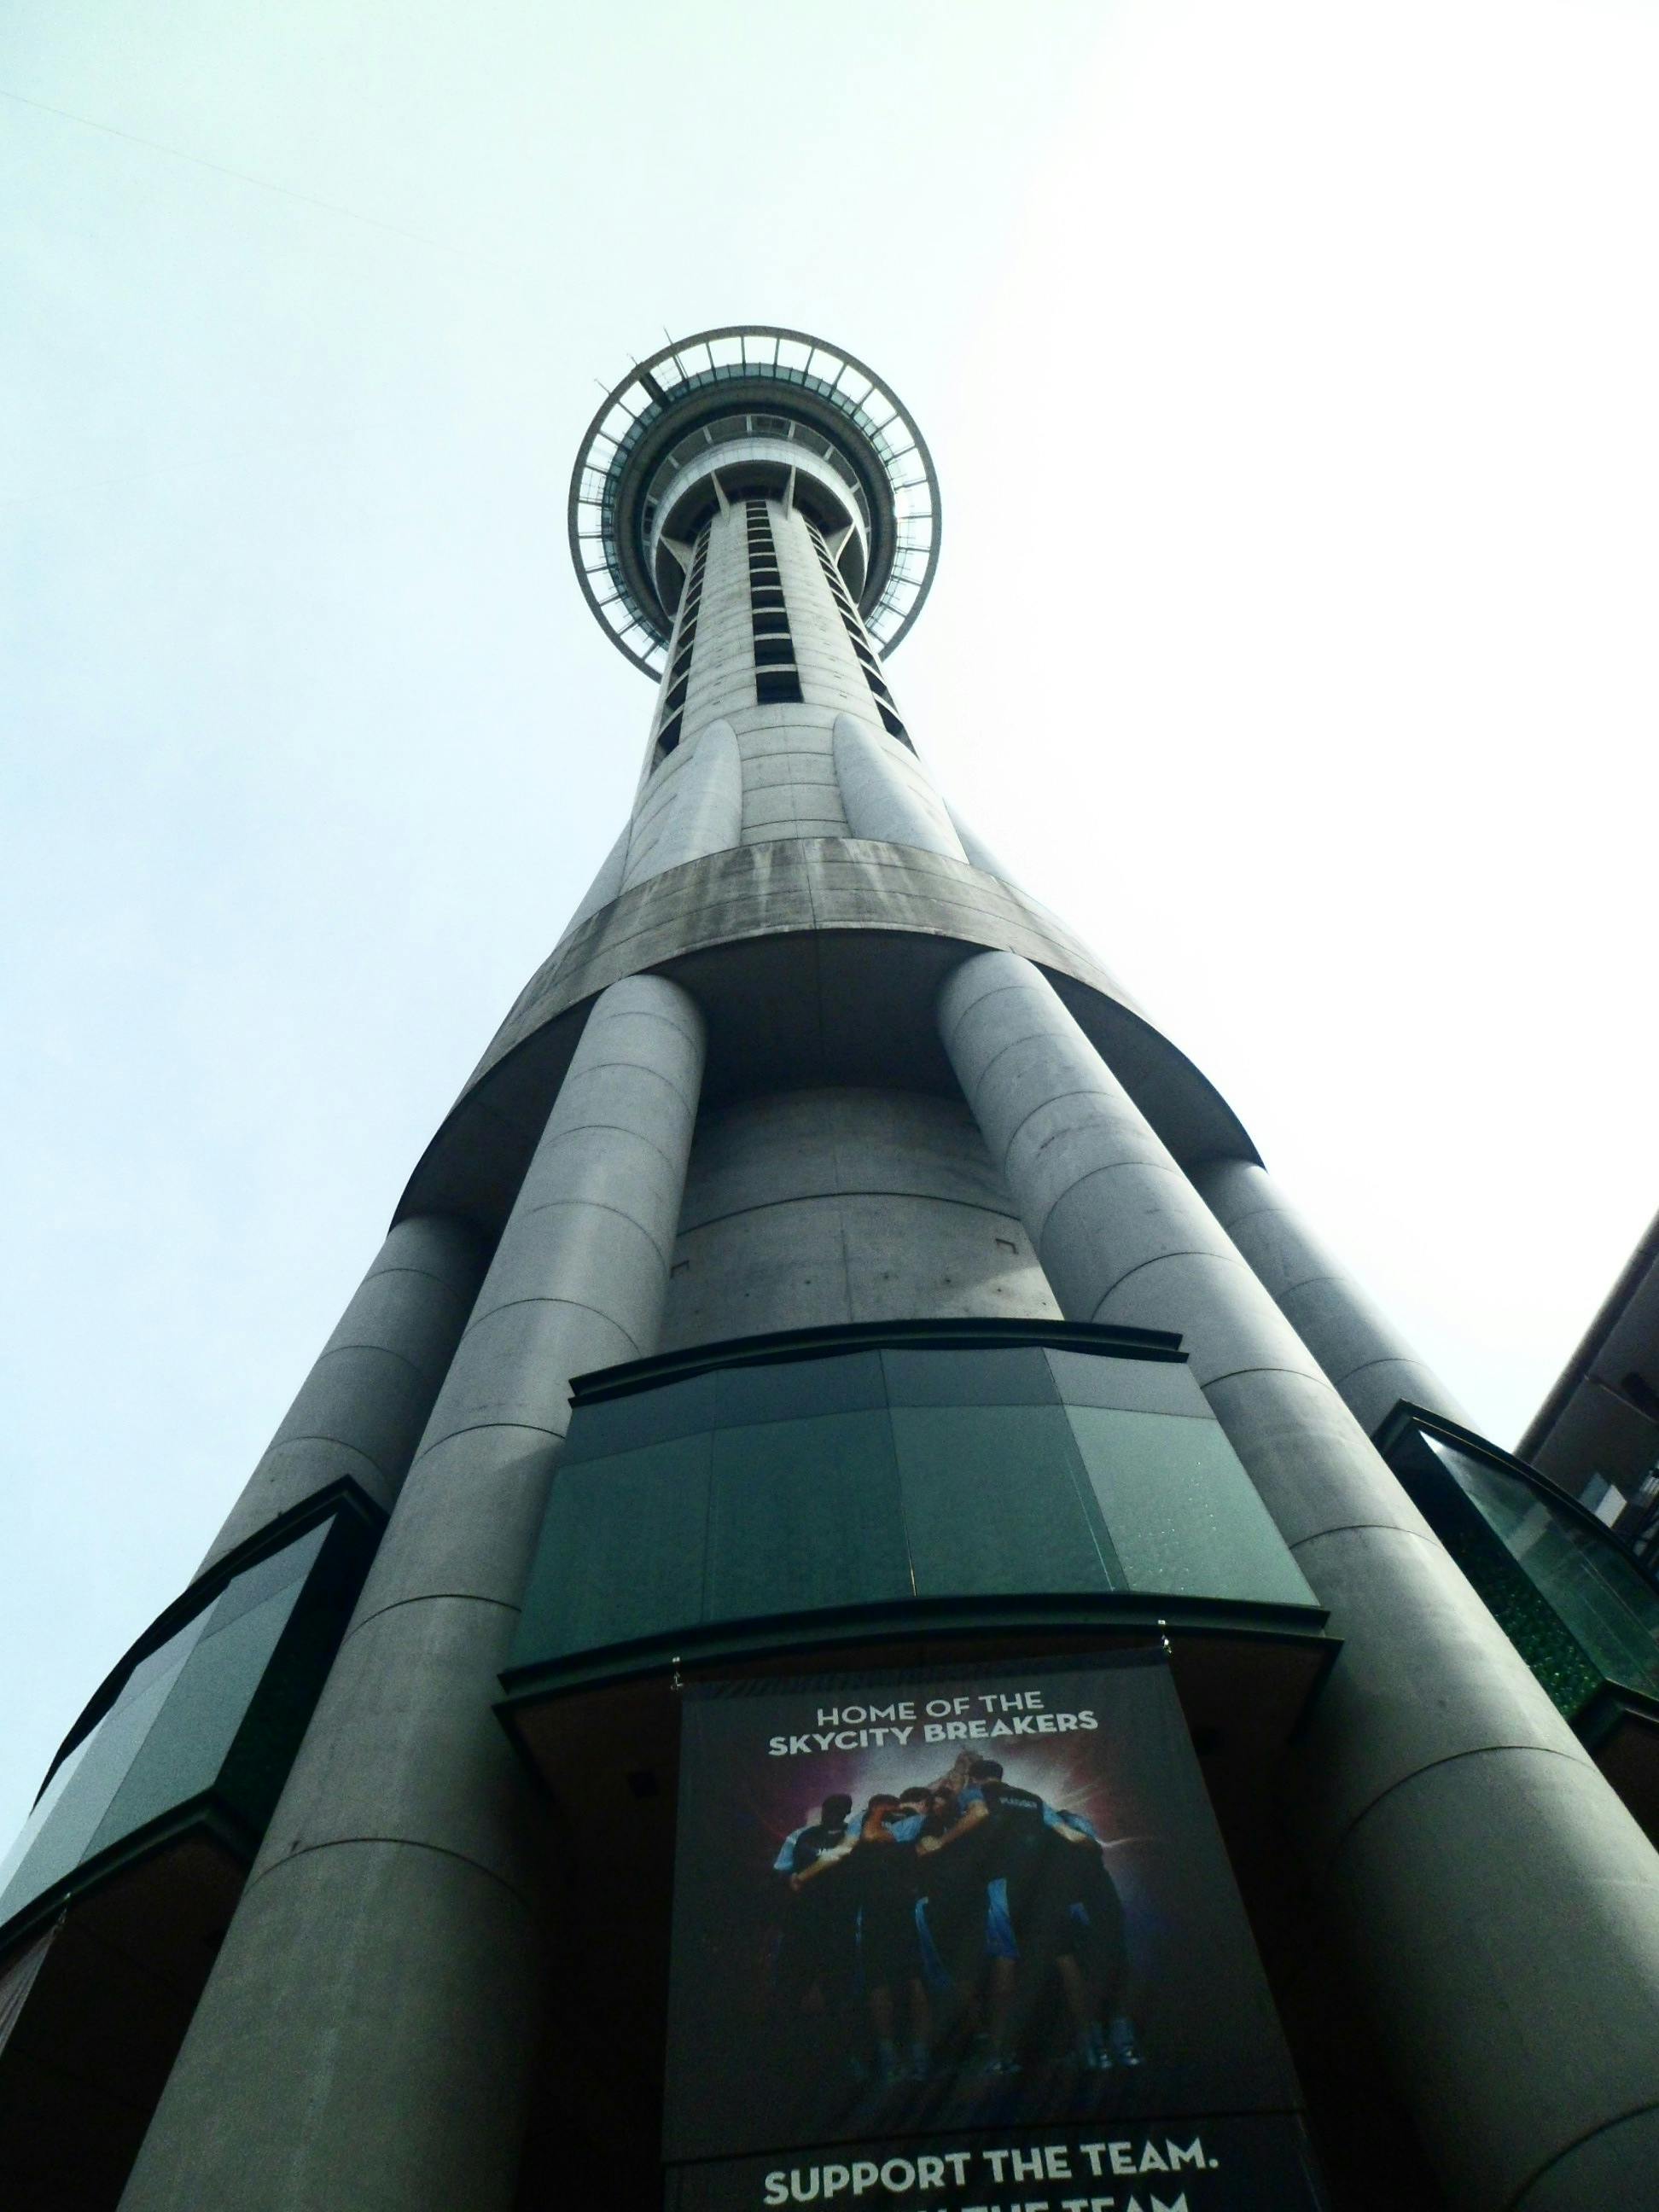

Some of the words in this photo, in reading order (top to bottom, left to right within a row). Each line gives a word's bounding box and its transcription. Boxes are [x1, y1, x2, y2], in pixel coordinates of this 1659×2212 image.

[817, 1702, 917, 1726] HOME
[925, 1697, 970, 1717] OF
[978, 1691, 1045, 1713] THE
[769, 1726, 914, 1756] SKYCITY
[923, 1710, 1098, 1743] BREAKERS
[763, 2151, 971, 2206] SUPPORT
[982, 2145, 1073, 2183] THE
[1080, 2137, 1220, 2176] TEAM.
